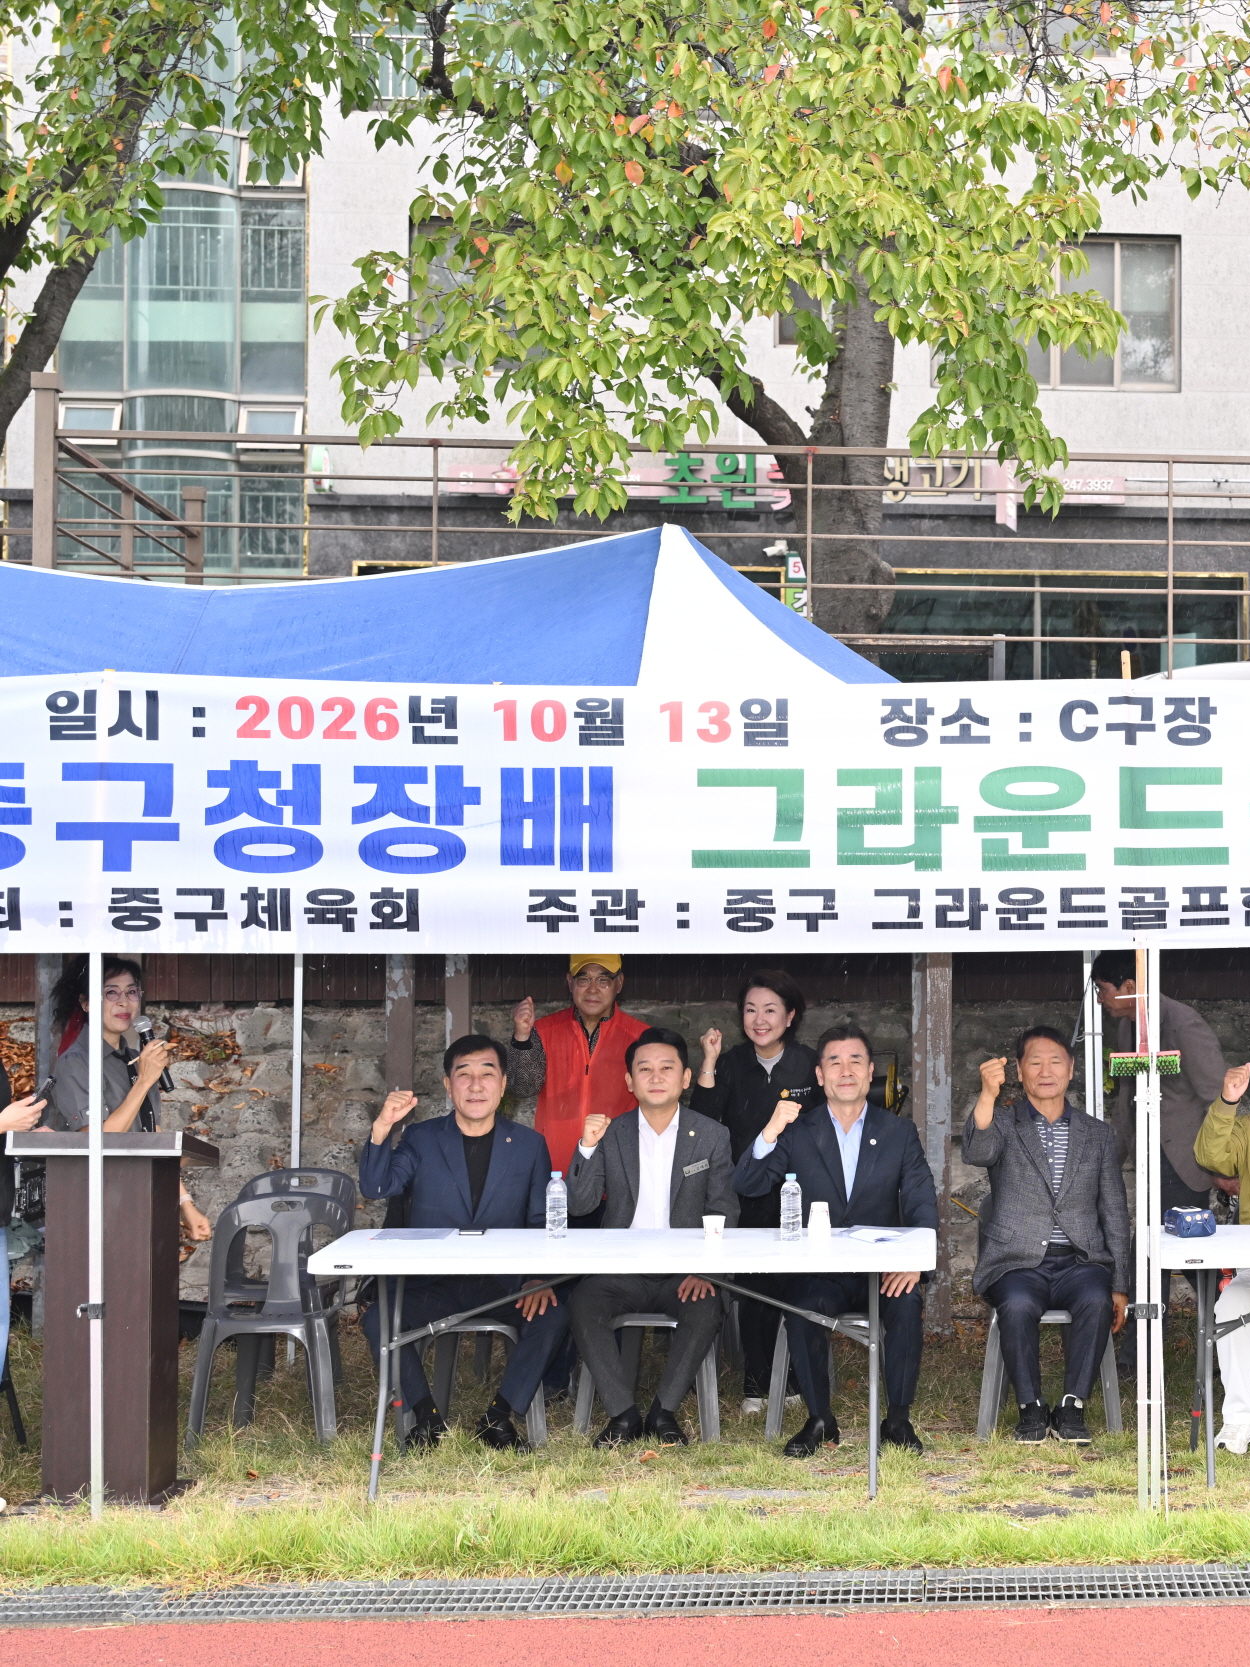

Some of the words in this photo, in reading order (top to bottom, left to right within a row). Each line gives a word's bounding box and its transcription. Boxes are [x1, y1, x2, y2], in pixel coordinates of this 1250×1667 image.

[660, 453, 755, 508] 초원
[46, 690, 159, 741] 일시
[193, 706, 206, 738] :
[236, 696, 459, 745] 2026년
[494, 698, 625, 747] 10월
[660, 699, 789, 747] 13일
[880, 698, 991, 748] 장소
[1019, 712, 1032, 742] :
[1059, 696, 1218, 747] C구장
[0, 760, 614, 875] 구청장배
[108, 887, 420, 933] 중구체육회
[527, 888, 646, 933] 주관
[676, 902, 690, 929] :
[724, 888, 839, 933] 중구
